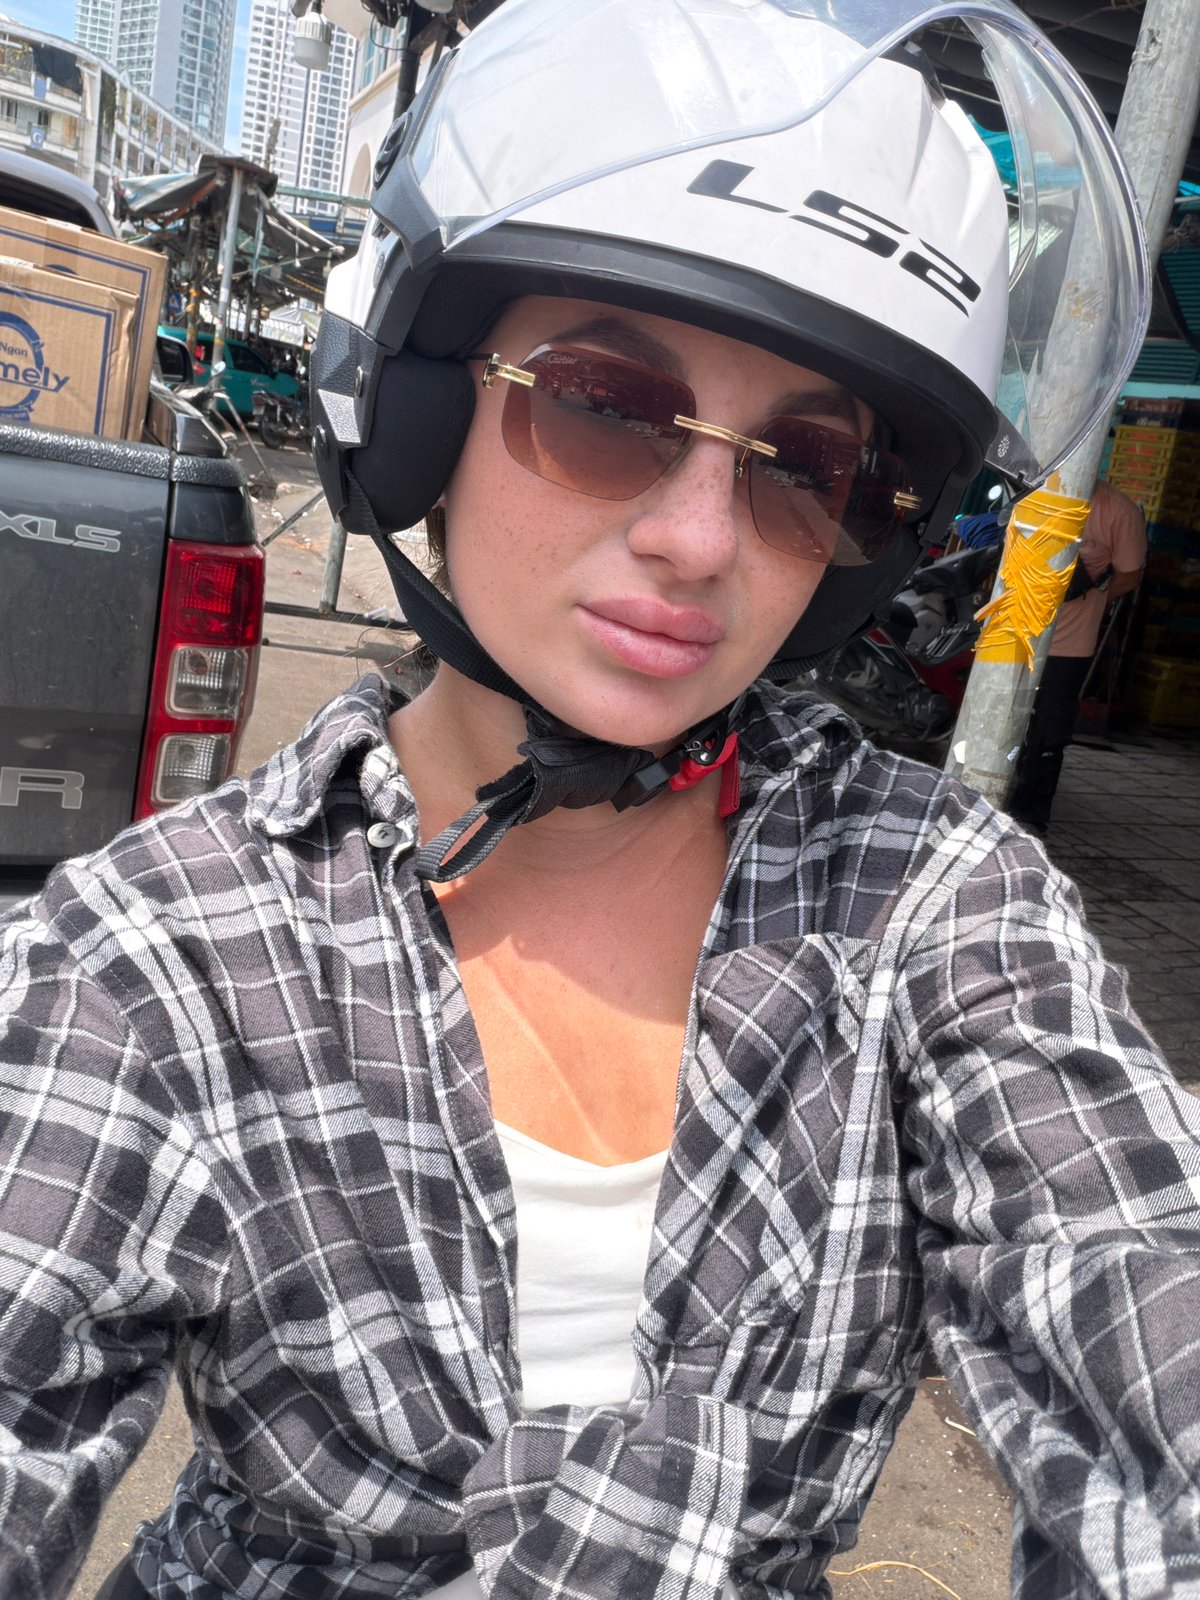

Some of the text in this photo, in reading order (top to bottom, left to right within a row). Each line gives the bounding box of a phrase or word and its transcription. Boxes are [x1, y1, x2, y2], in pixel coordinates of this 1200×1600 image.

[686, 159, 981, 318] LS2
[547, 354, 578, 365] Cartier
[0, 510, 121, 553] XLS
[0, 766, 85, 809] R
